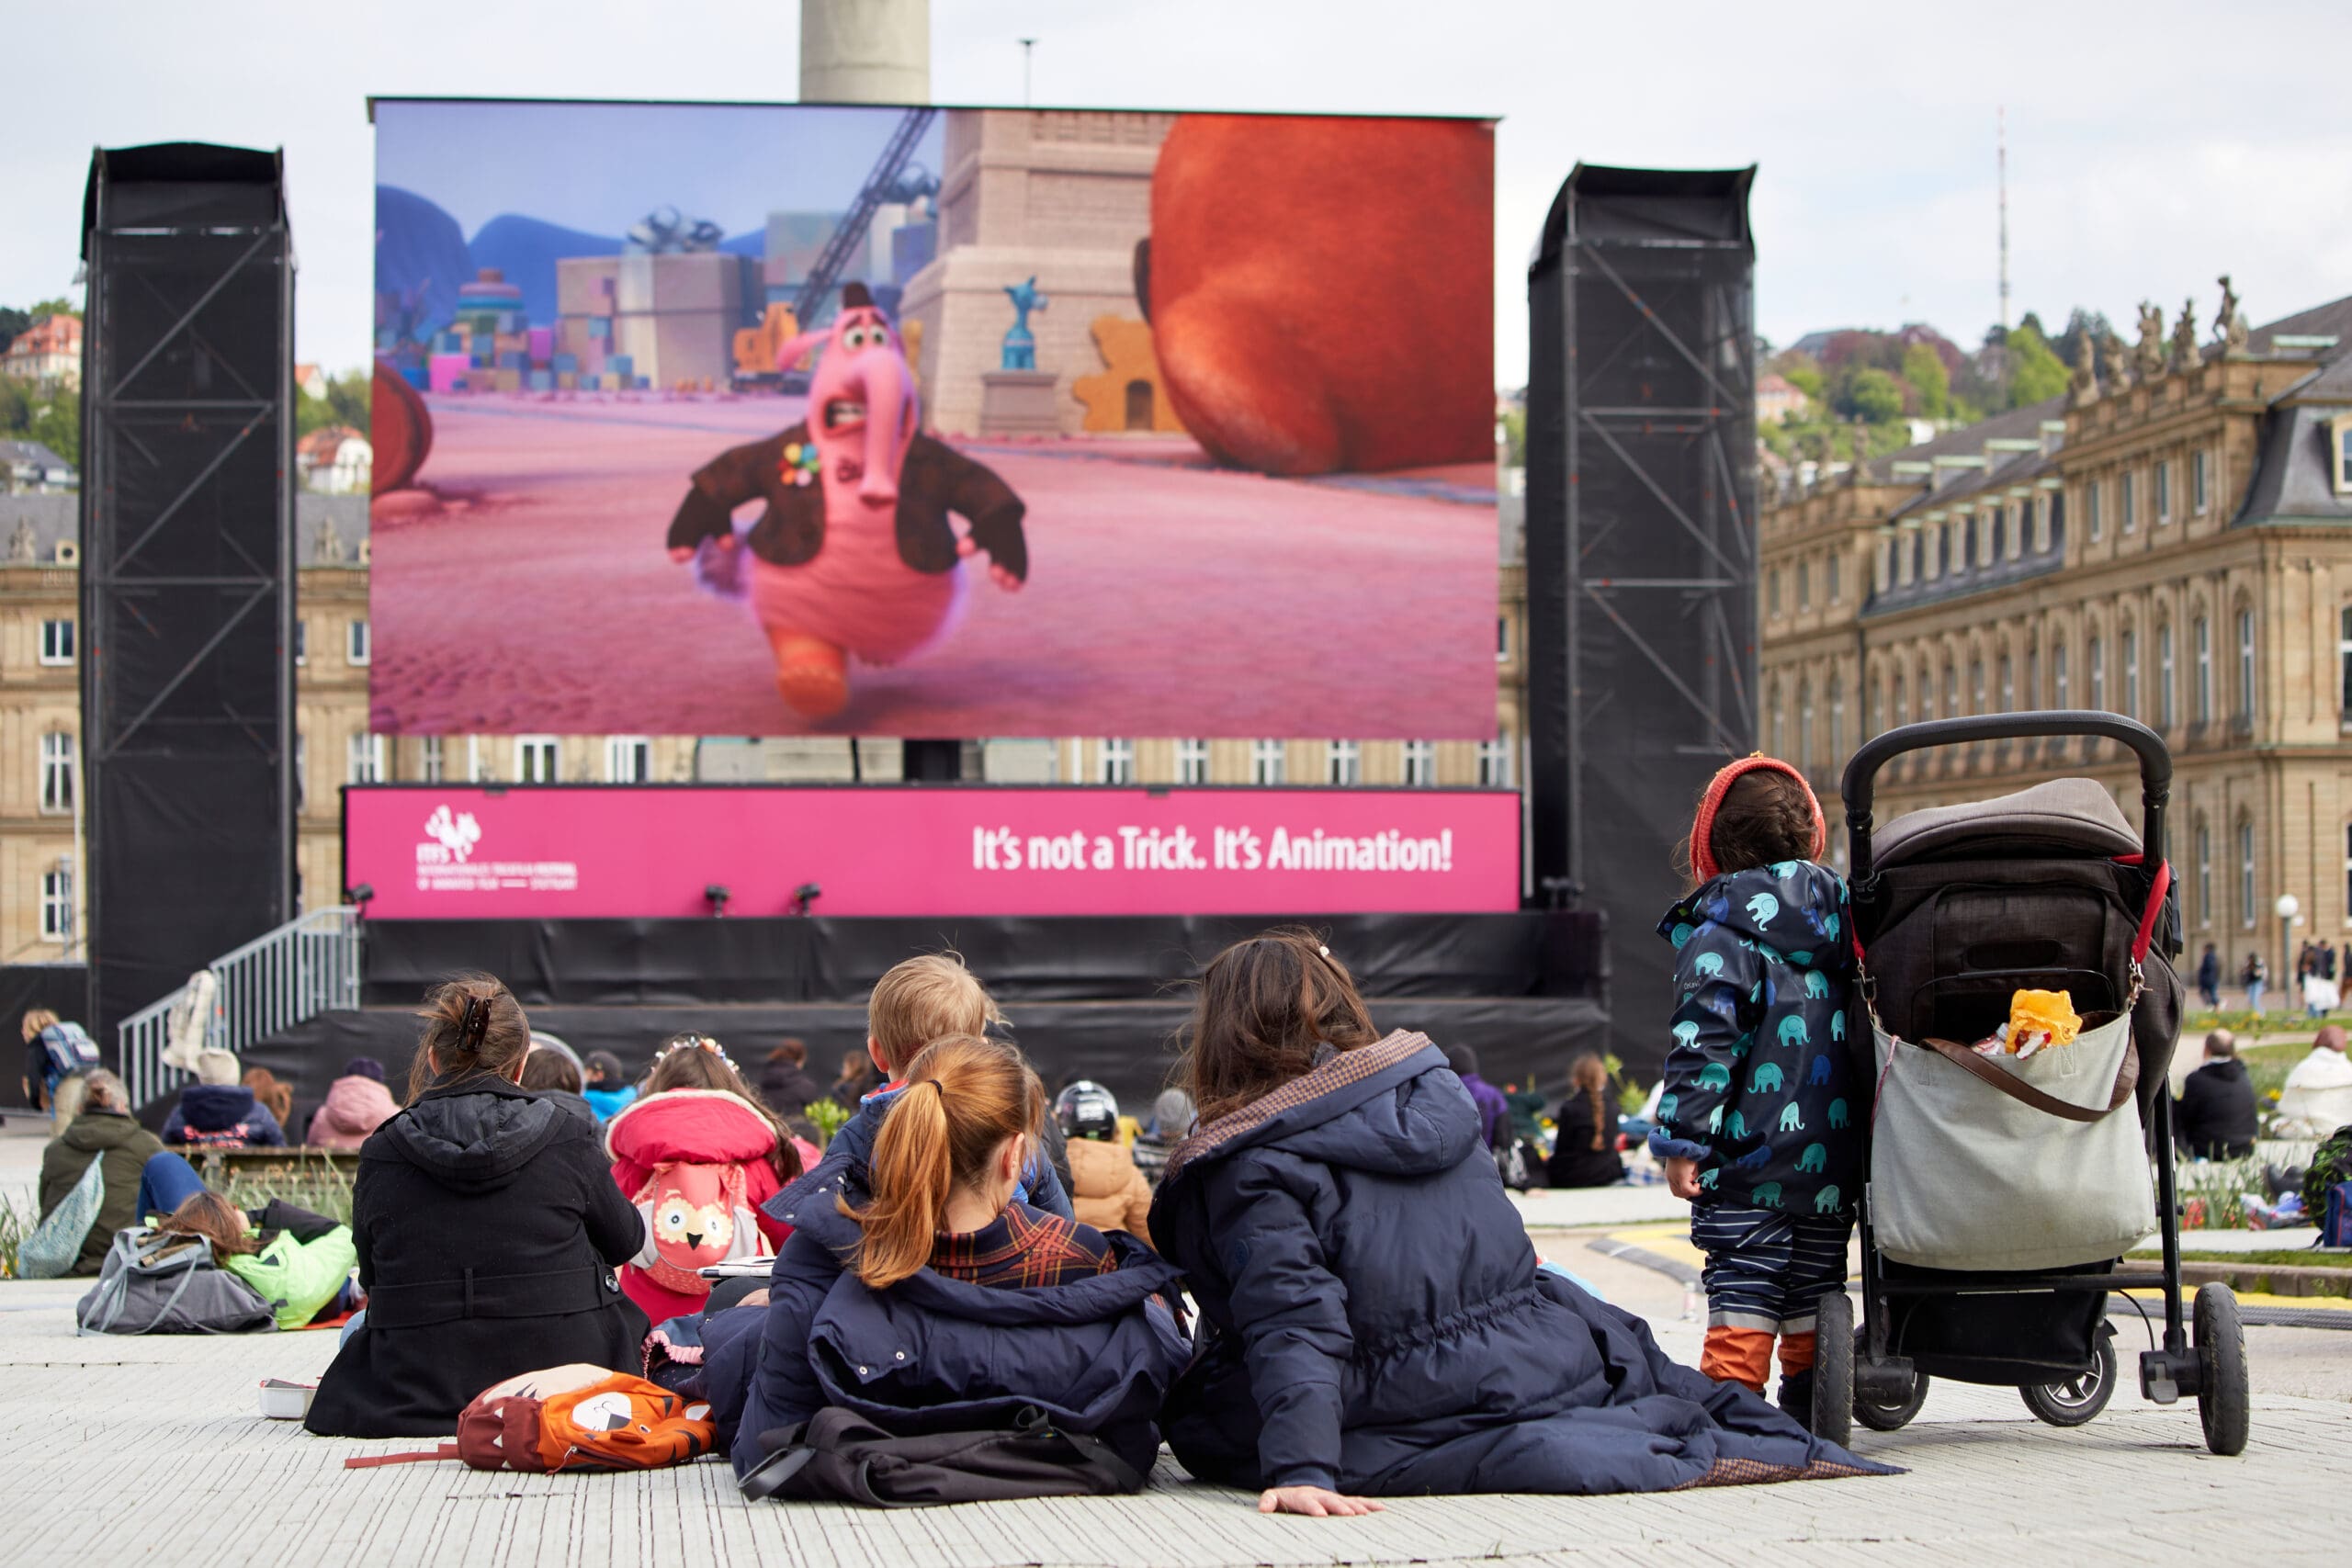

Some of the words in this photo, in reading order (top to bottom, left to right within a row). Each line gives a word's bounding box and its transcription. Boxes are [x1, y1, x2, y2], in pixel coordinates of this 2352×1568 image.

[1028, 829, 1086, 870] not
[1091, 836, 1114, 870] a
[1118, 826, 1206, 870] Trick.
[1267, 827, 1453, 872] Animation!
